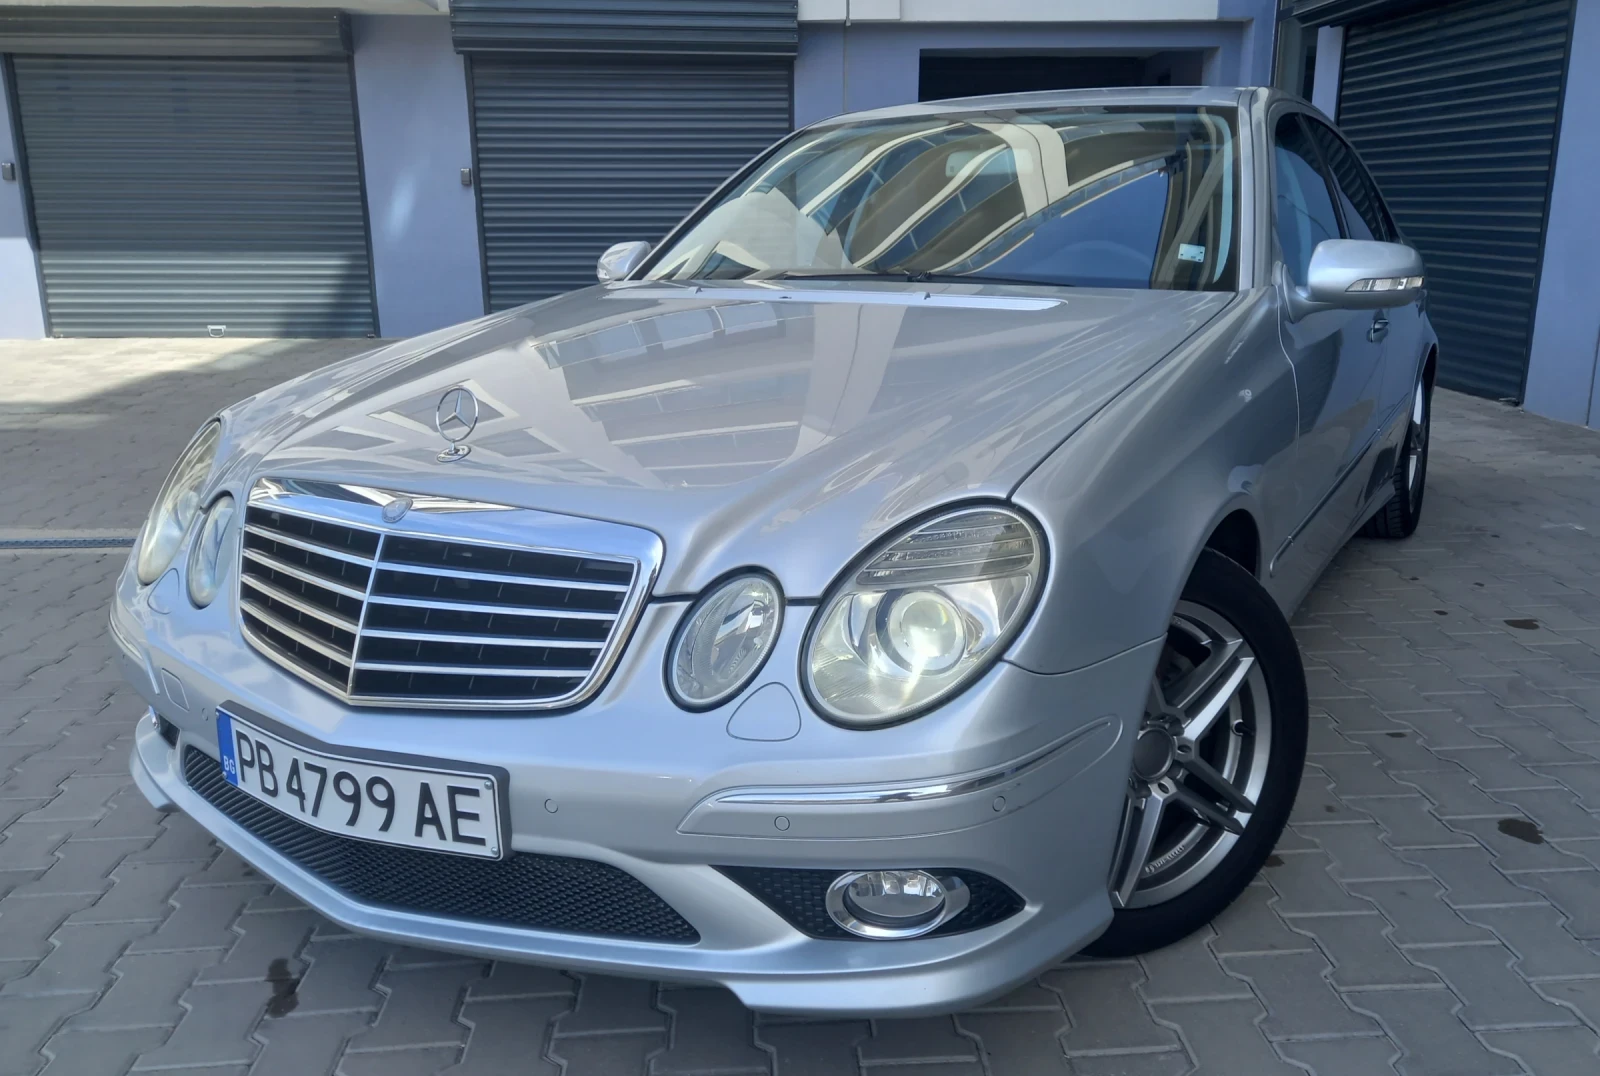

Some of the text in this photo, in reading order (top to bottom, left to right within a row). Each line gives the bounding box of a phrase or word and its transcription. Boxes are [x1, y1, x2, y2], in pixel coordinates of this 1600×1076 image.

[223, 755, 236, 775] BG
[235, 729, 487, 847] PB 4799 AE
